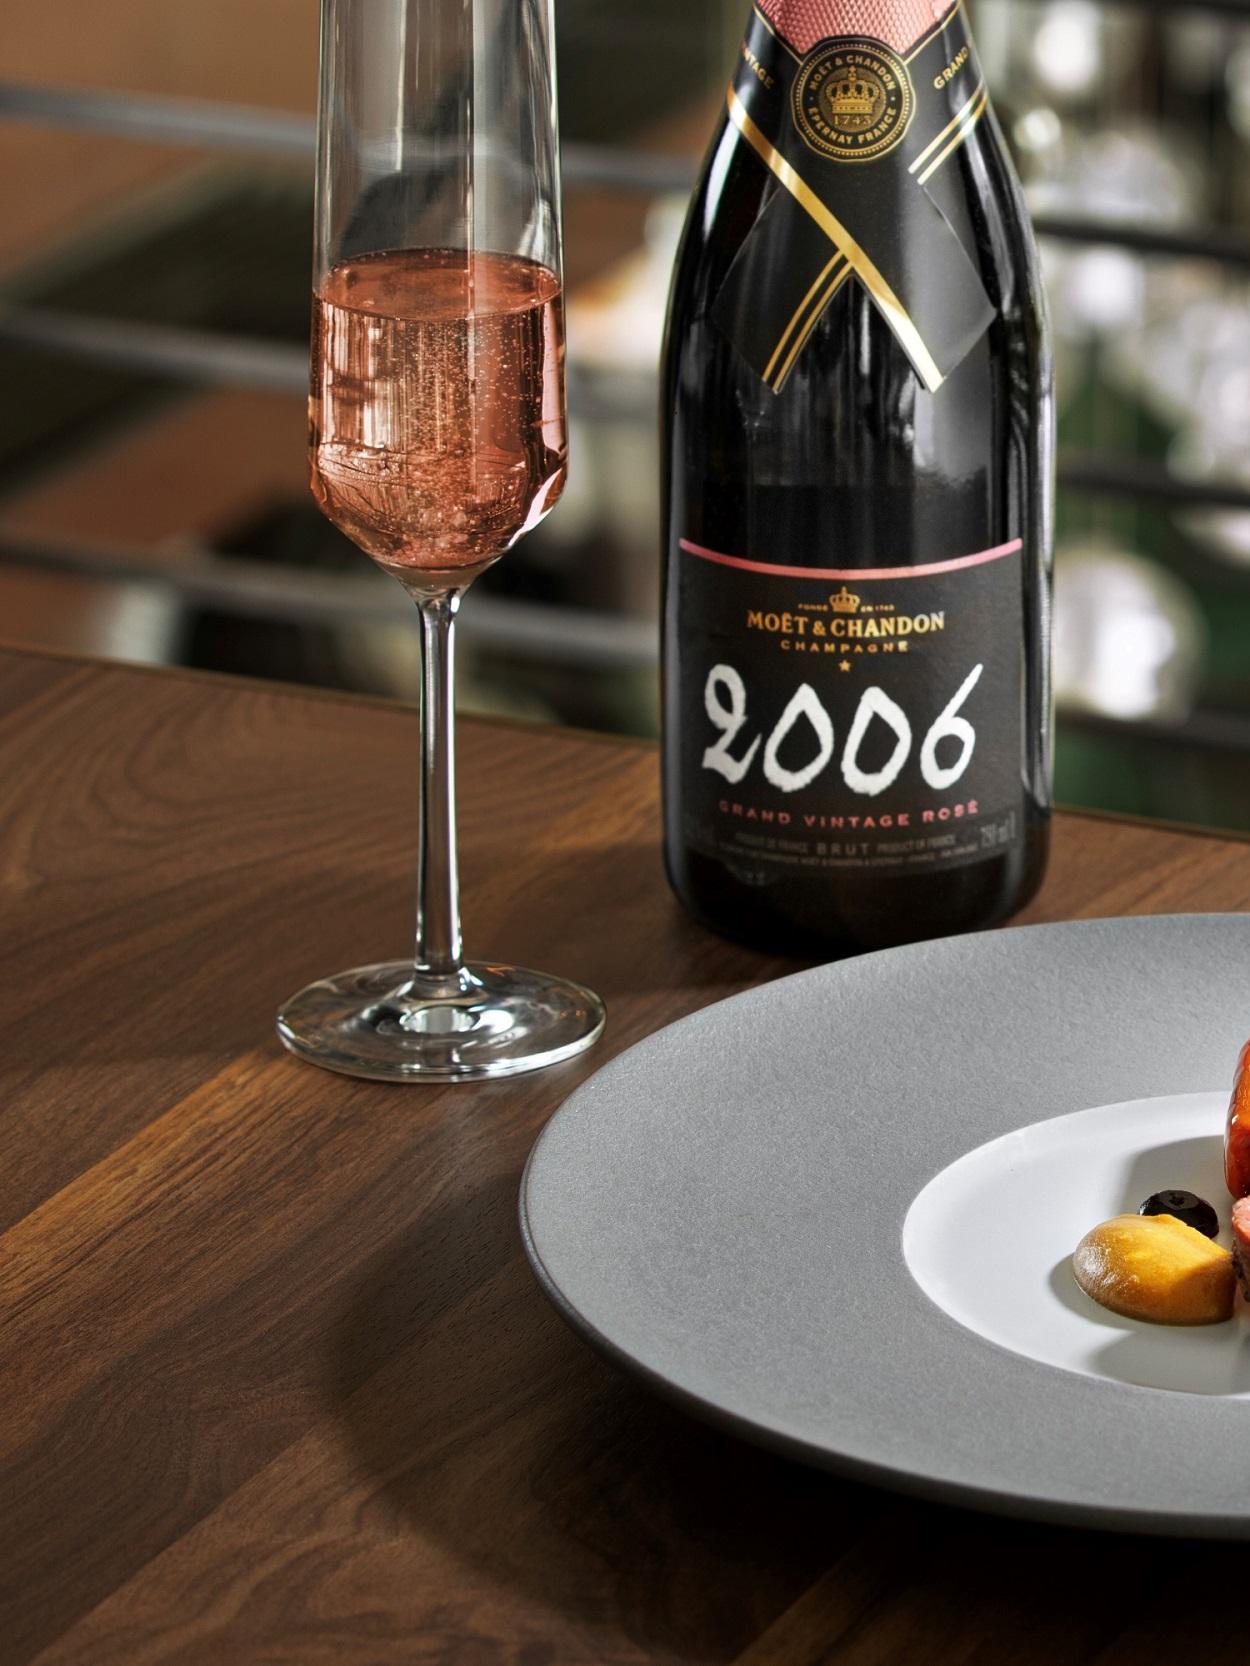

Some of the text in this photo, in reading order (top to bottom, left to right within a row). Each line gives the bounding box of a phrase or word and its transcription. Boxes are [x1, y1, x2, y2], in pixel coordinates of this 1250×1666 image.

[835, 57, 844, 66] &
[846, 54, 897, 91] CHANDON
[933, 46, 969, 90] GRAND
[857, 107, 897, 144] FRANCE
[812, 621, 826, 637] &
[829, 610, 946, 638] CHANDON
[780, 640, 910, 654] CHAMPAGNE
[701, 662, 984, 797] 2006
[718, 799, 791, 826] GRAND
[803, 813, 910, 829] VINTAGE
[816, 841, 870, 857] BRUT
